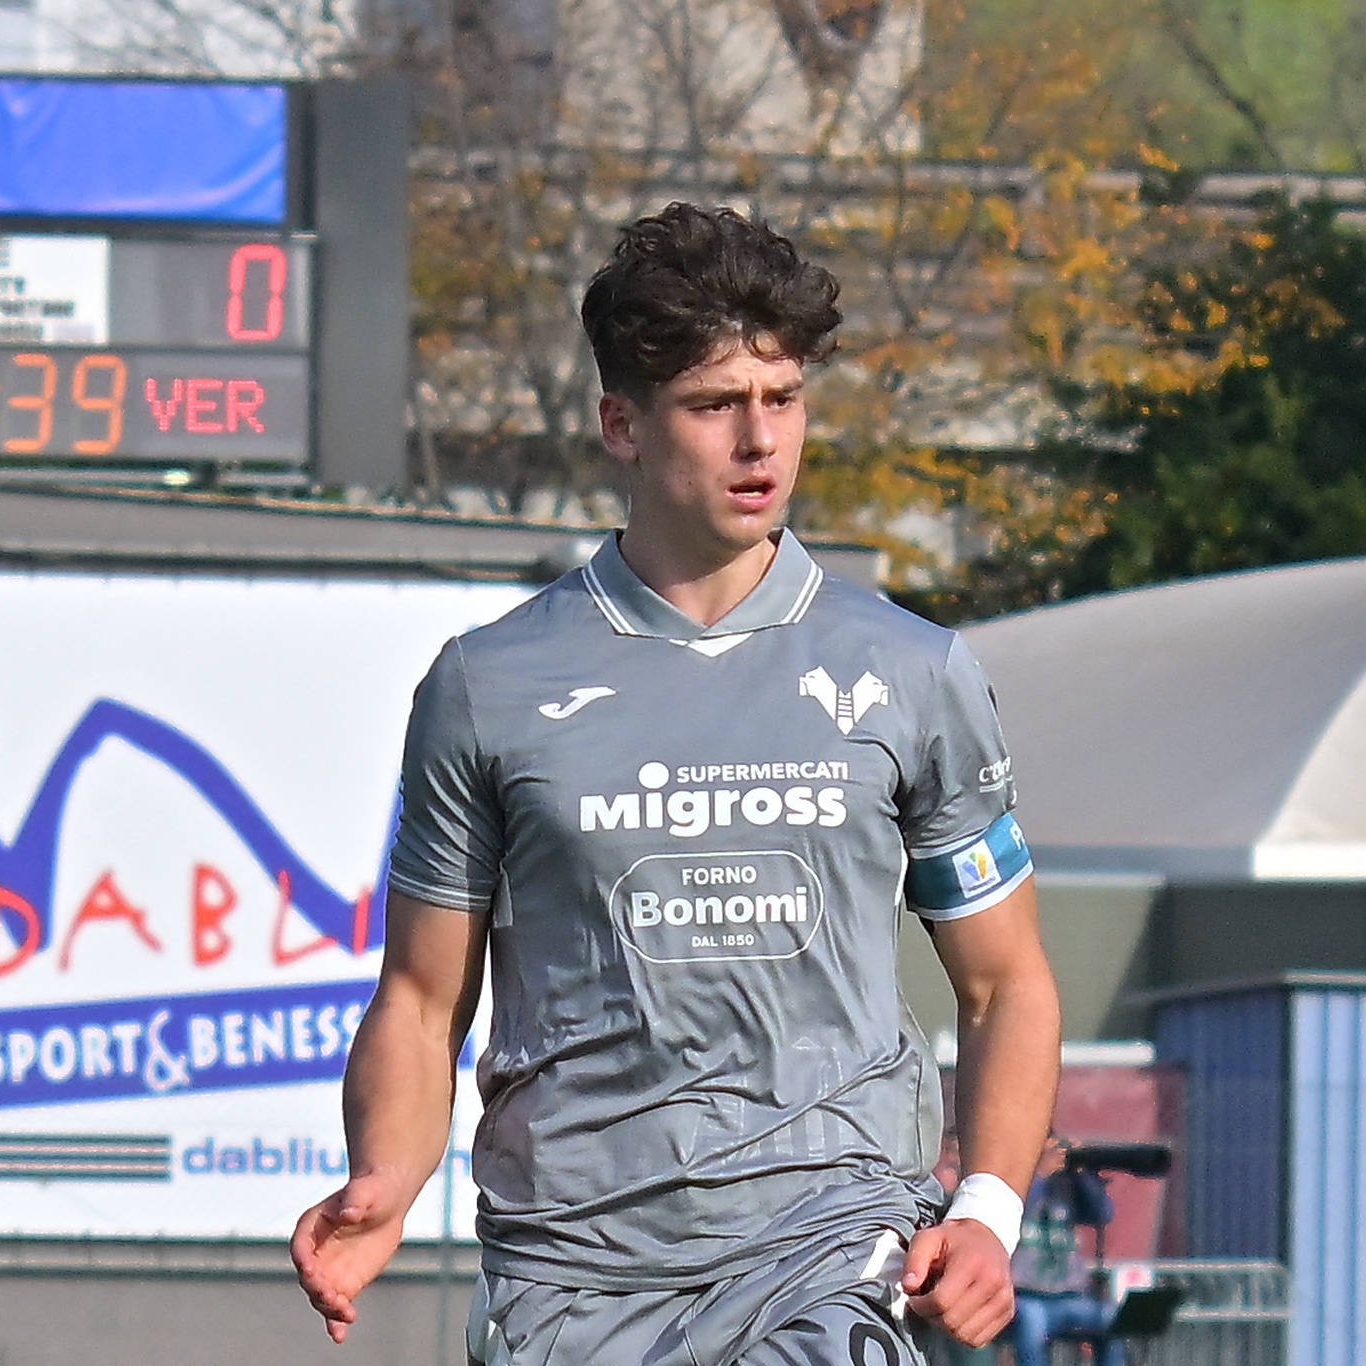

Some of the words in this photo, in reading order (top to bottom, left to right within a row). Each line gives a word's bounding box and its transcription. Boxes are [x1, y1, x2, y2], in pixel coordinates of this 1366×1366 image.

[226, 243, 288, 341] 0
[145, 378, 266, 433] VER
[676, 761, 849, 784] SUPERMERCATI
[579, 761, 848, 838] Migross
[681, 865, 758, 886] FORNO
[631, 886, 808, 928] Bonomi
[691, 936, 719, 948] DAL
[722, 933, 755, 947] 1850
[182, 1136, 348, 1177] dabliu
